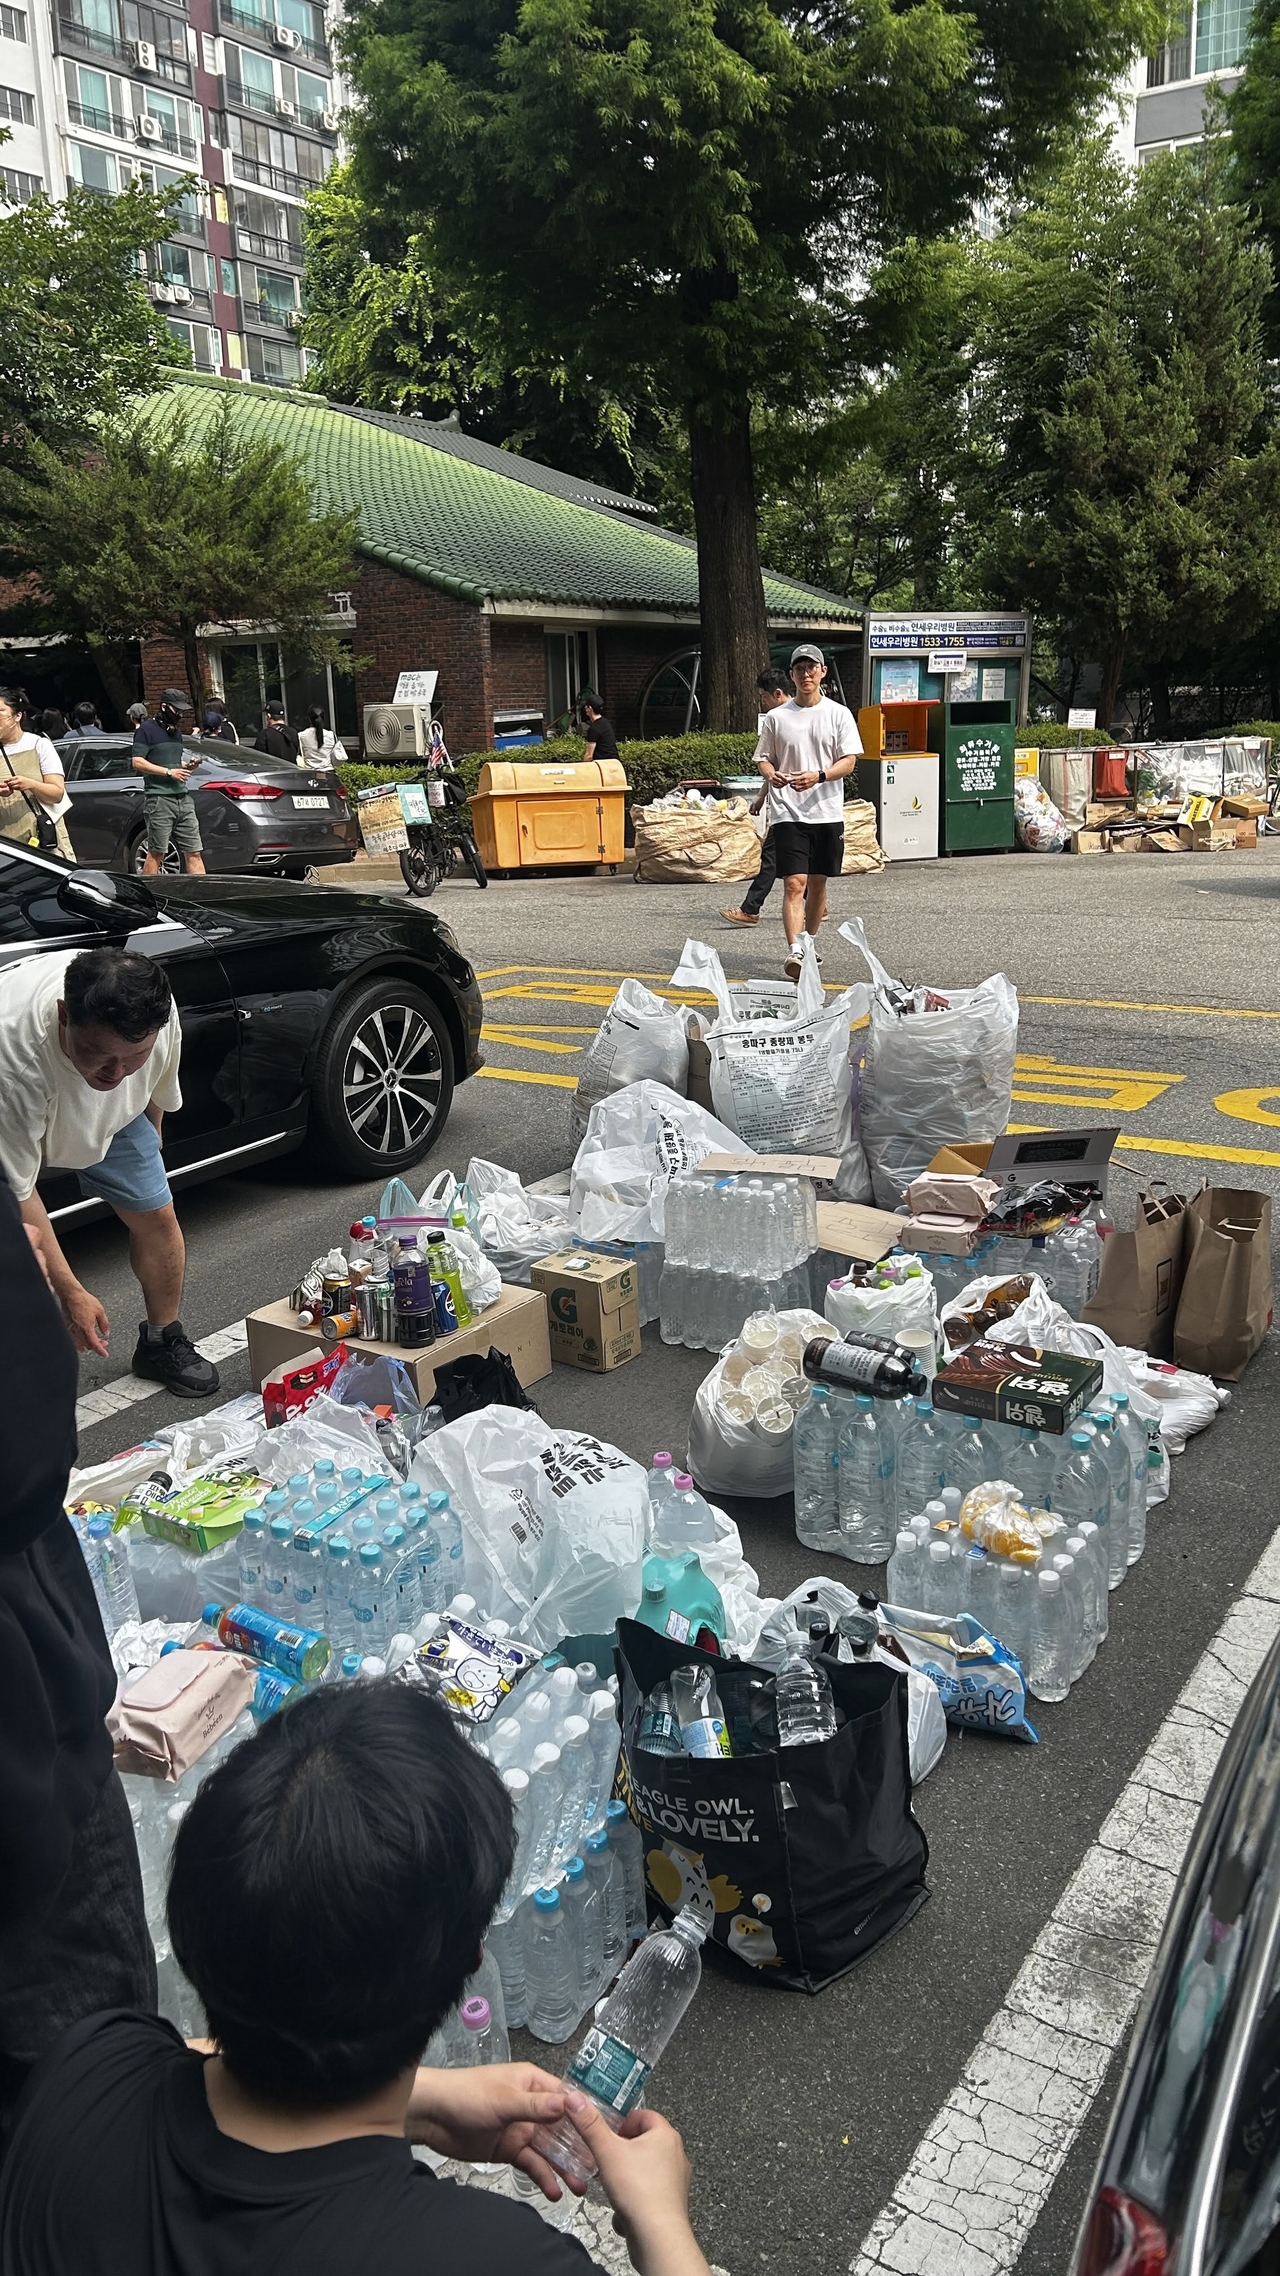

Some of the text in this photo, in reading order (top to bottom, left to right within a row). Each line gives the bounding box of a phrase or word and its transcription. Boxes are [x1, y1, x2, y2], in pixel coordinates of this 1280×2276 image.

[911, 621, 955, 633] 연세우리병원
[871, 635, 918, 648] 연세우리병원
[920, 637, 965, 647] 1533-1755
[742, 1034, 815, 1048] 송파구 종량제 봉투
[549, 1320, 584, 1339] 게토레이
[1008, 1375, 1071, 1397] 쉘위
[1005, 1401, 1046, 1427] 쉘위
[632, 1777, 755, 1816] EAGLE OWL.
